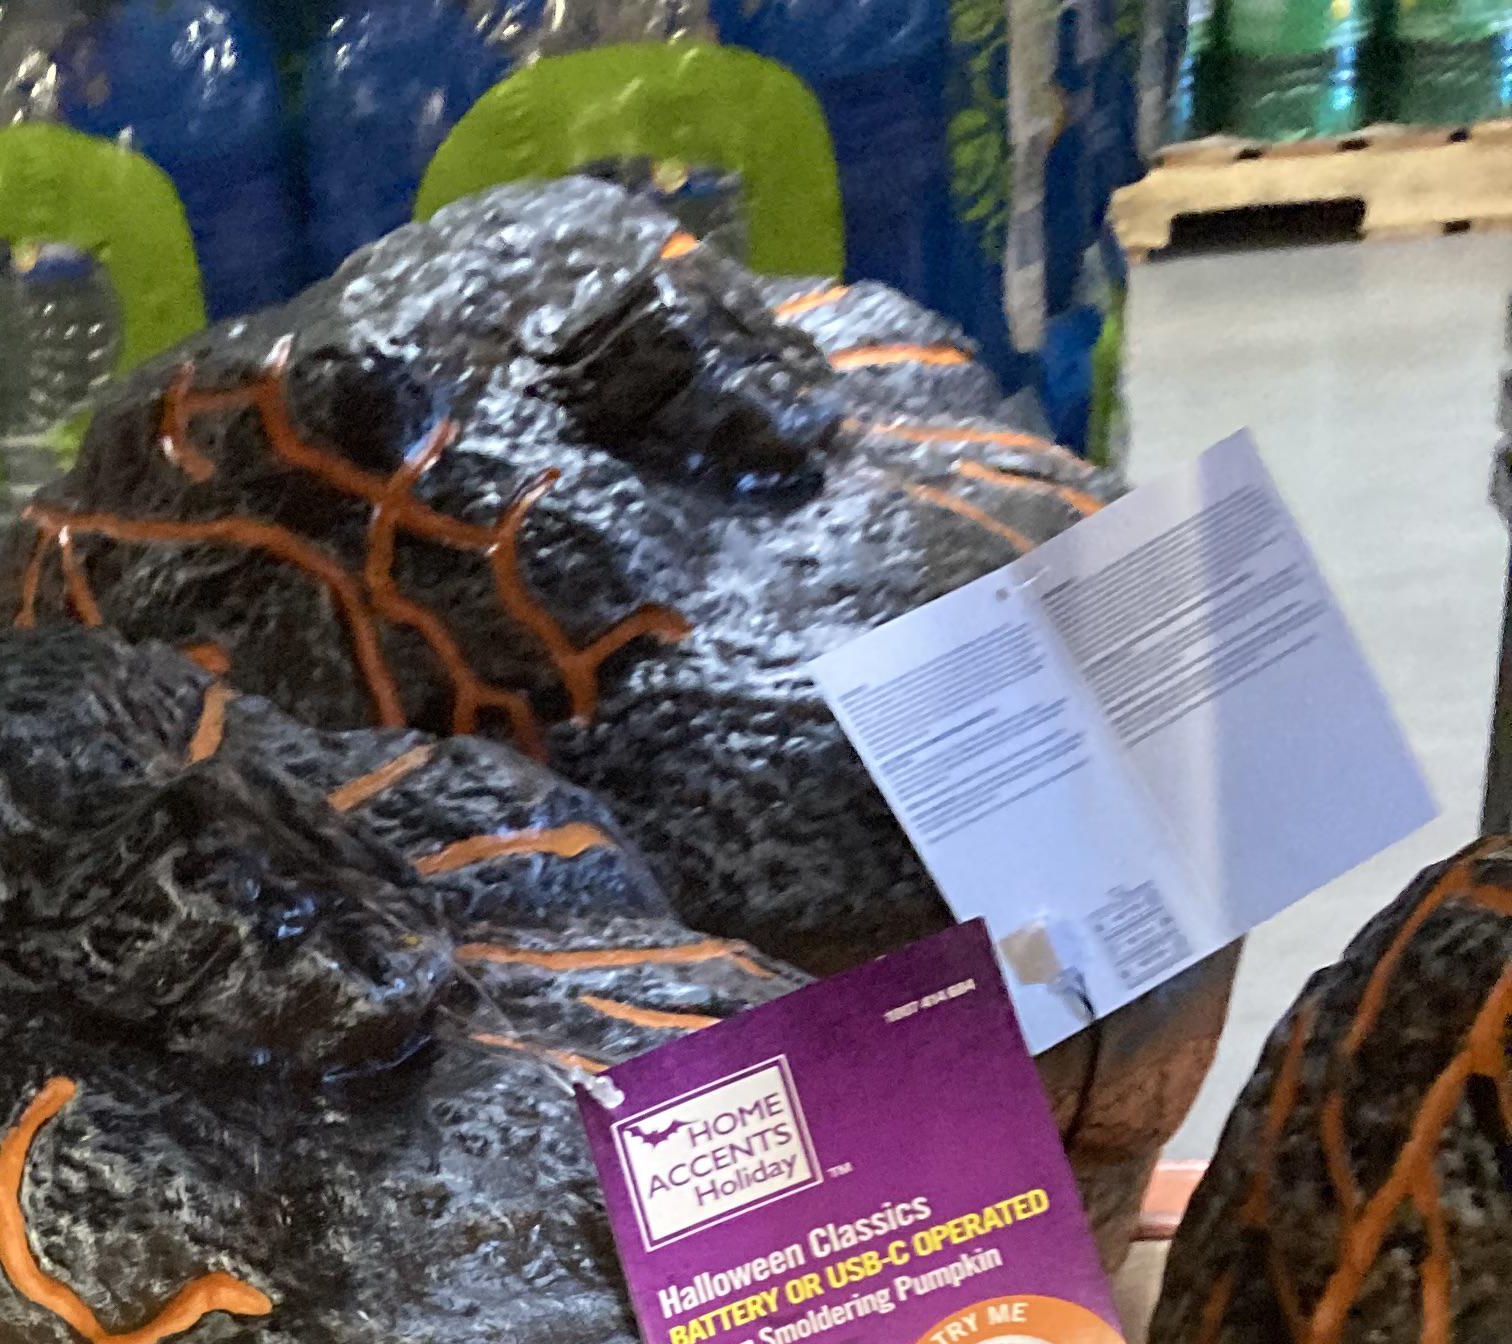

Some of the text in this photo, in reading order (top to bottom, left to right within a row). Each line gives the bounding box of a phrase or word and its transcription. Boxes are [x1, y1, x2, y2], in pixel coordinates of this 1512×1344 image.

[688, 1092, 784, 1146] HOME
[649, 1123, 792, 1199] ACCENTS
[694, 1154, 797, 1206] Holiday
[657, 1197, 932, 1318] Halloween Classics
[785, 1272, 824, 1304] OR
[825, 1240, 910, 1288] USB-C
[911, 1188, 1049, 1256] OPERATED
[893, 1247, 1003, 1301] Pumpkin
[987, 1303, 1029, 1325] ME
